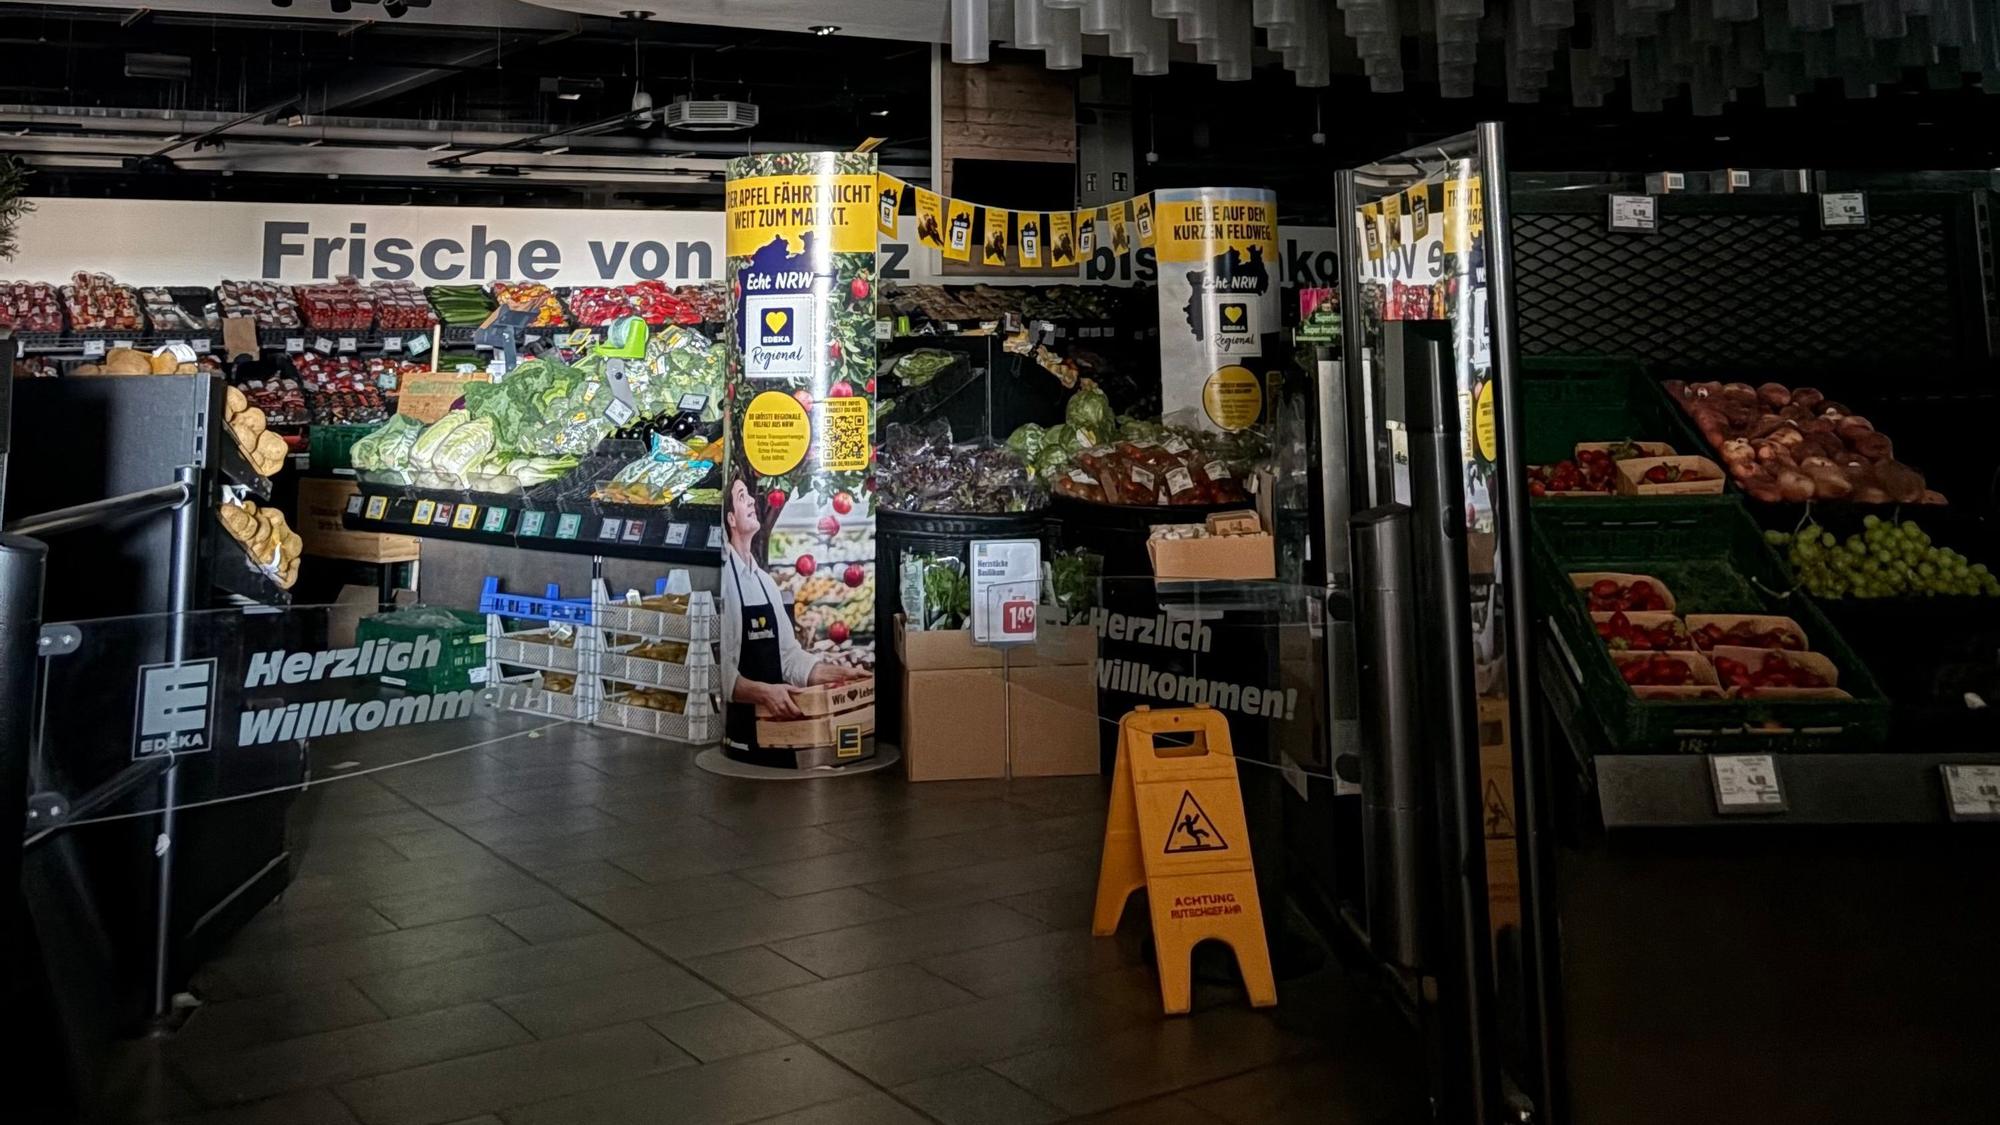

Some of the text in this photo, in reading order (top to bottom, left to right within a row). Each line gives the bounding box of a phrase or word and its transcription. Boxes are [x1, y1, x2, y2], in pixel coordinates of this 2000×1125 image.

[739, 186, 770, 207] APFEL
[774, 182, 820, 204] FÄHRT
[827, 184, 872, 204] NICHT
[734, 208, 756, 230] WEIT
[758, 208, 787, 228] ZUM
[1223, 206, 1246, 222] AUF
[1248, 206, 1266, 222] DEM
[262, 221, 562, 281] Frische
[587, 240, 714, 280] von
[1087, 234, 1158, 281] bis
[746, 272, 814, 290] Echt NRW
[1230, 275, 1258, 289] NRW
[762, 336, 790, 344] EDEKA
[1214, 332, 1255, 352] Regional
[752, 346, 804, 370] Regional
[977, 568, 1006, 577] Basilikum
[1089, 606, 1213, 654] Herzlich
[243, 634, 442, 689] Herzlich
[832, 694, 846, 706] Wir
[1175, 893, 1235, 906] ACHTUNG
[1171, 905, 1241, 919] RUTSCHGEFAHR
